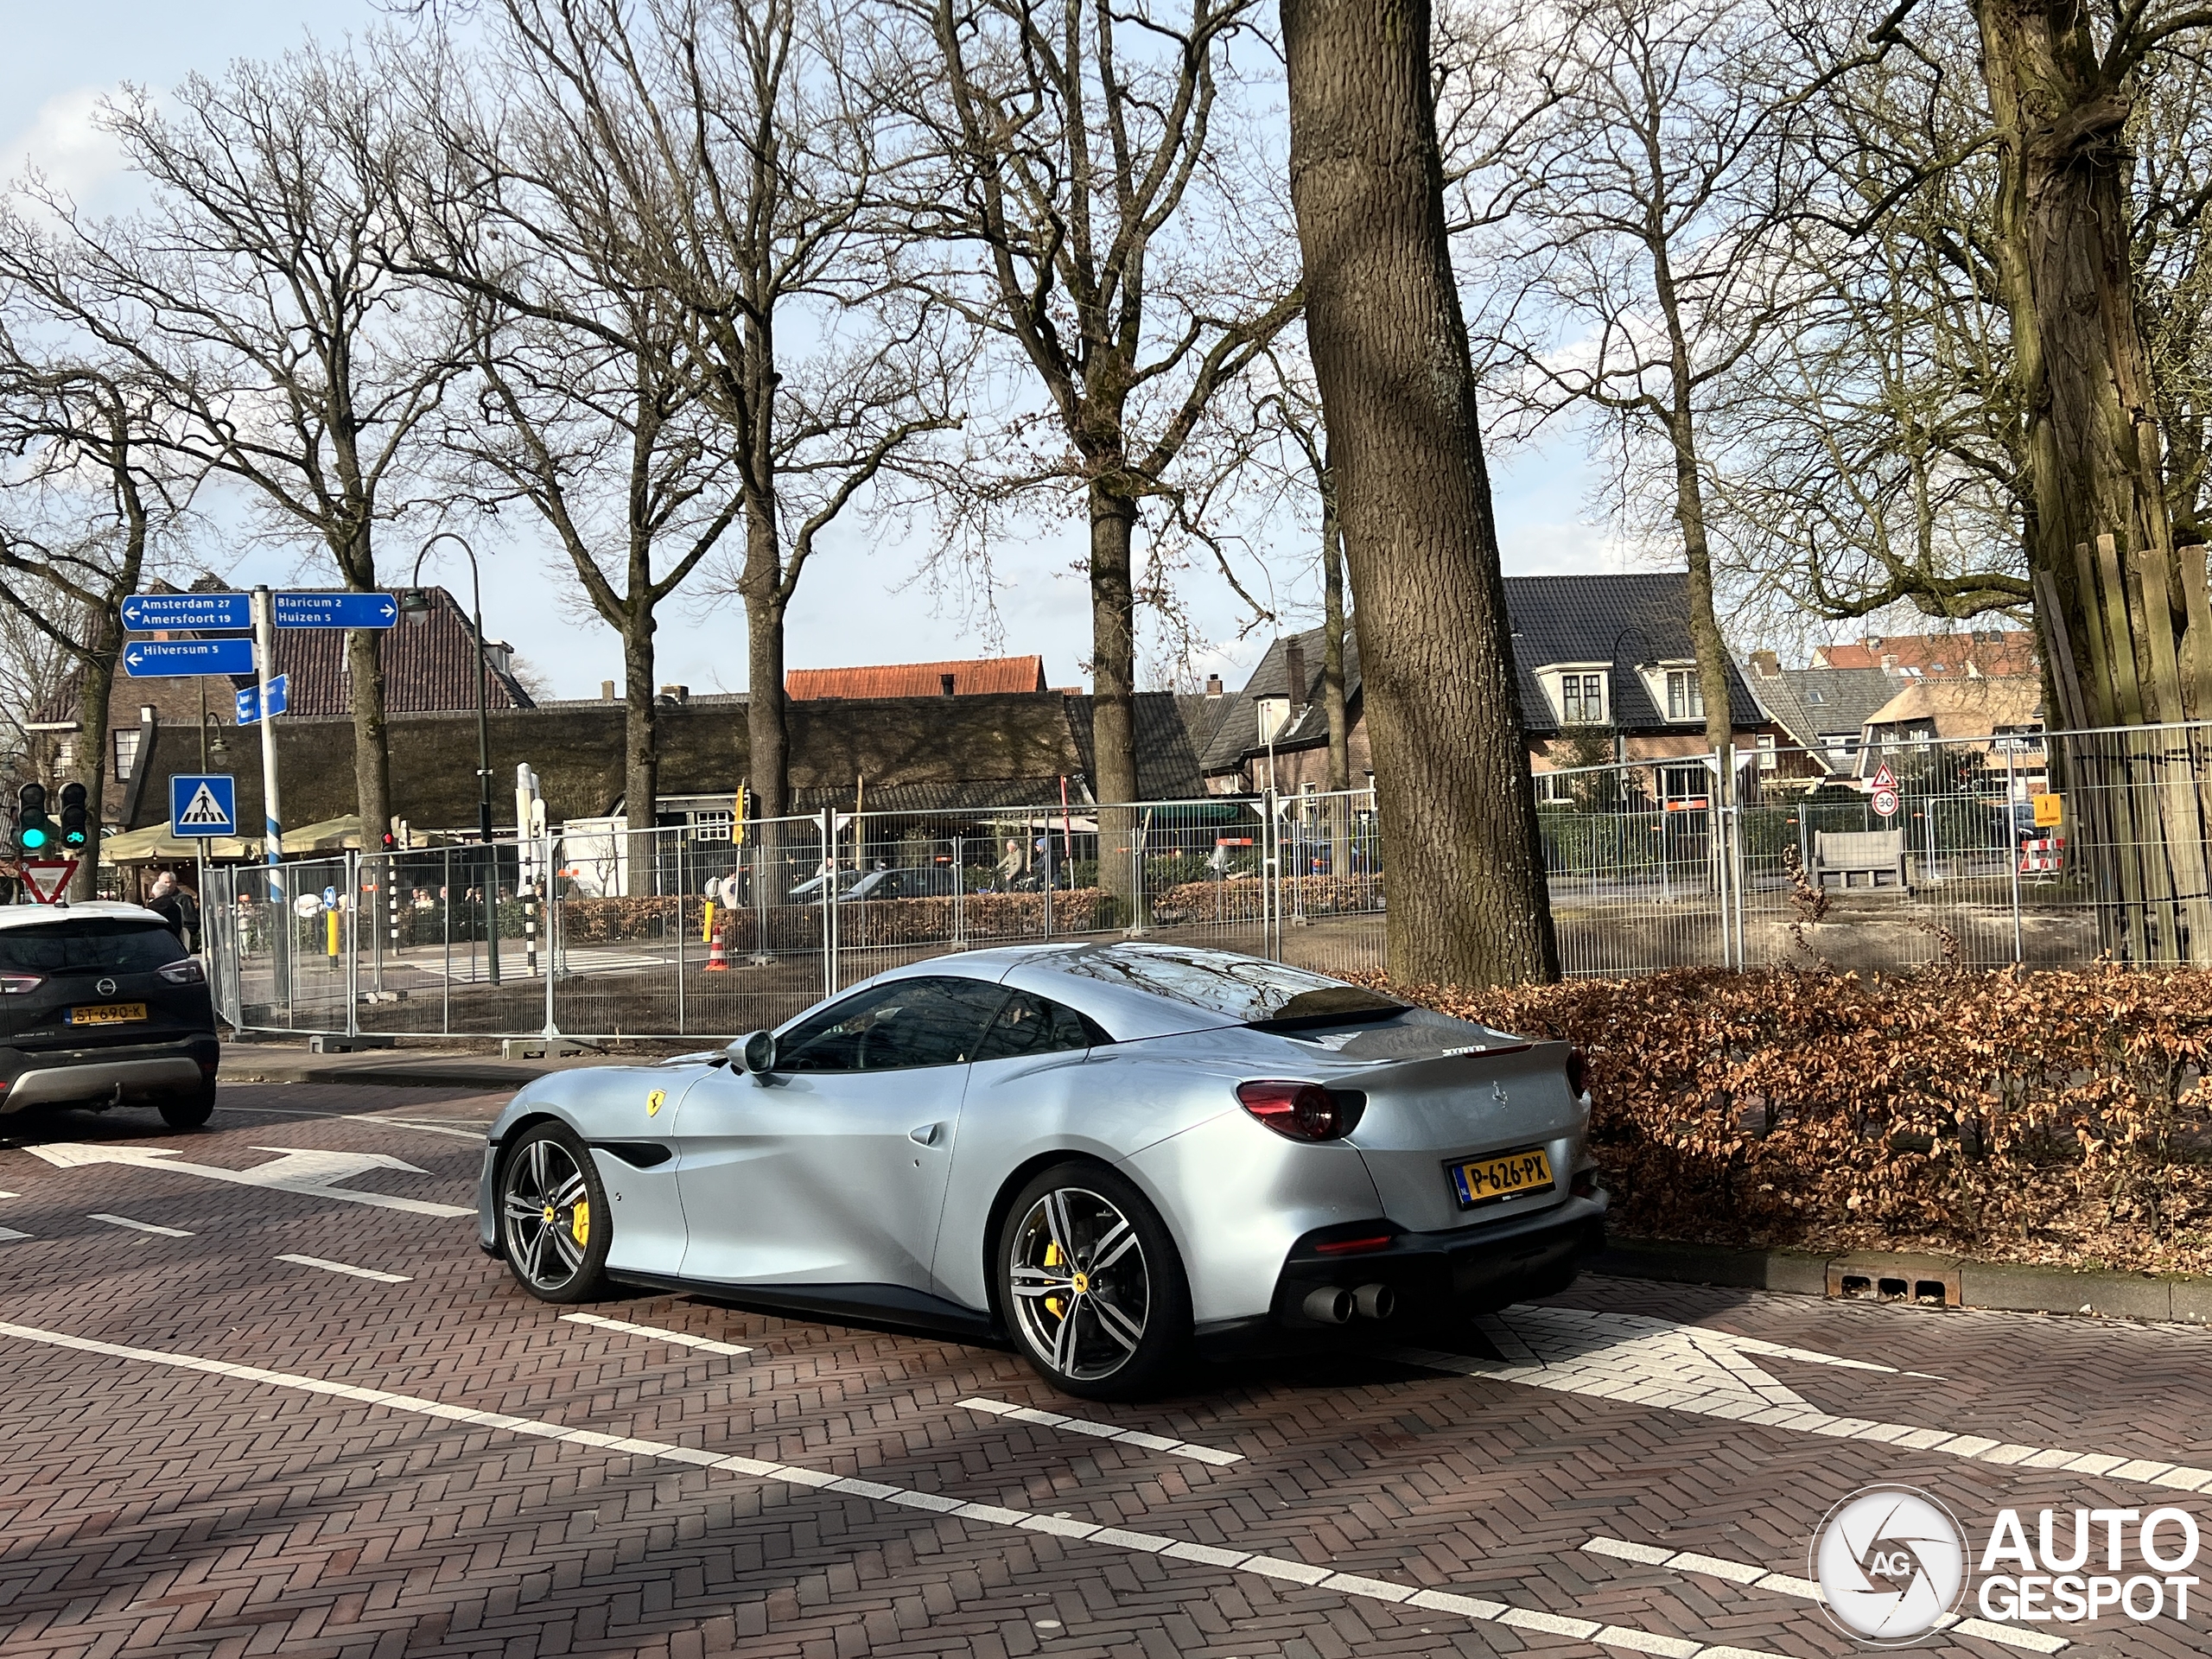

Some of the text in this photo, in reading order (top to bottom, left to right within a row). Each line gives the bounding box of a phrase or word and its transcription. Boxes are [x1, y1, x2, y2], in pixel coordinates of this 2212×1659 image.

[141, 598, 231, 610] Amsterdam 27
[277, 597, 342, 607] Blaricum 2
[142, 613, 232, 625] Amersfoort 19
[278, 612, 332, 622] Huizen 5
[143, 645, 219, 656] Hilversum 5
[1878, 797, 1894, 807] 30
[76, 1005, 142, 1021] ST-690-K
[1470, 1155, 1548, 1194] P-626-PX
